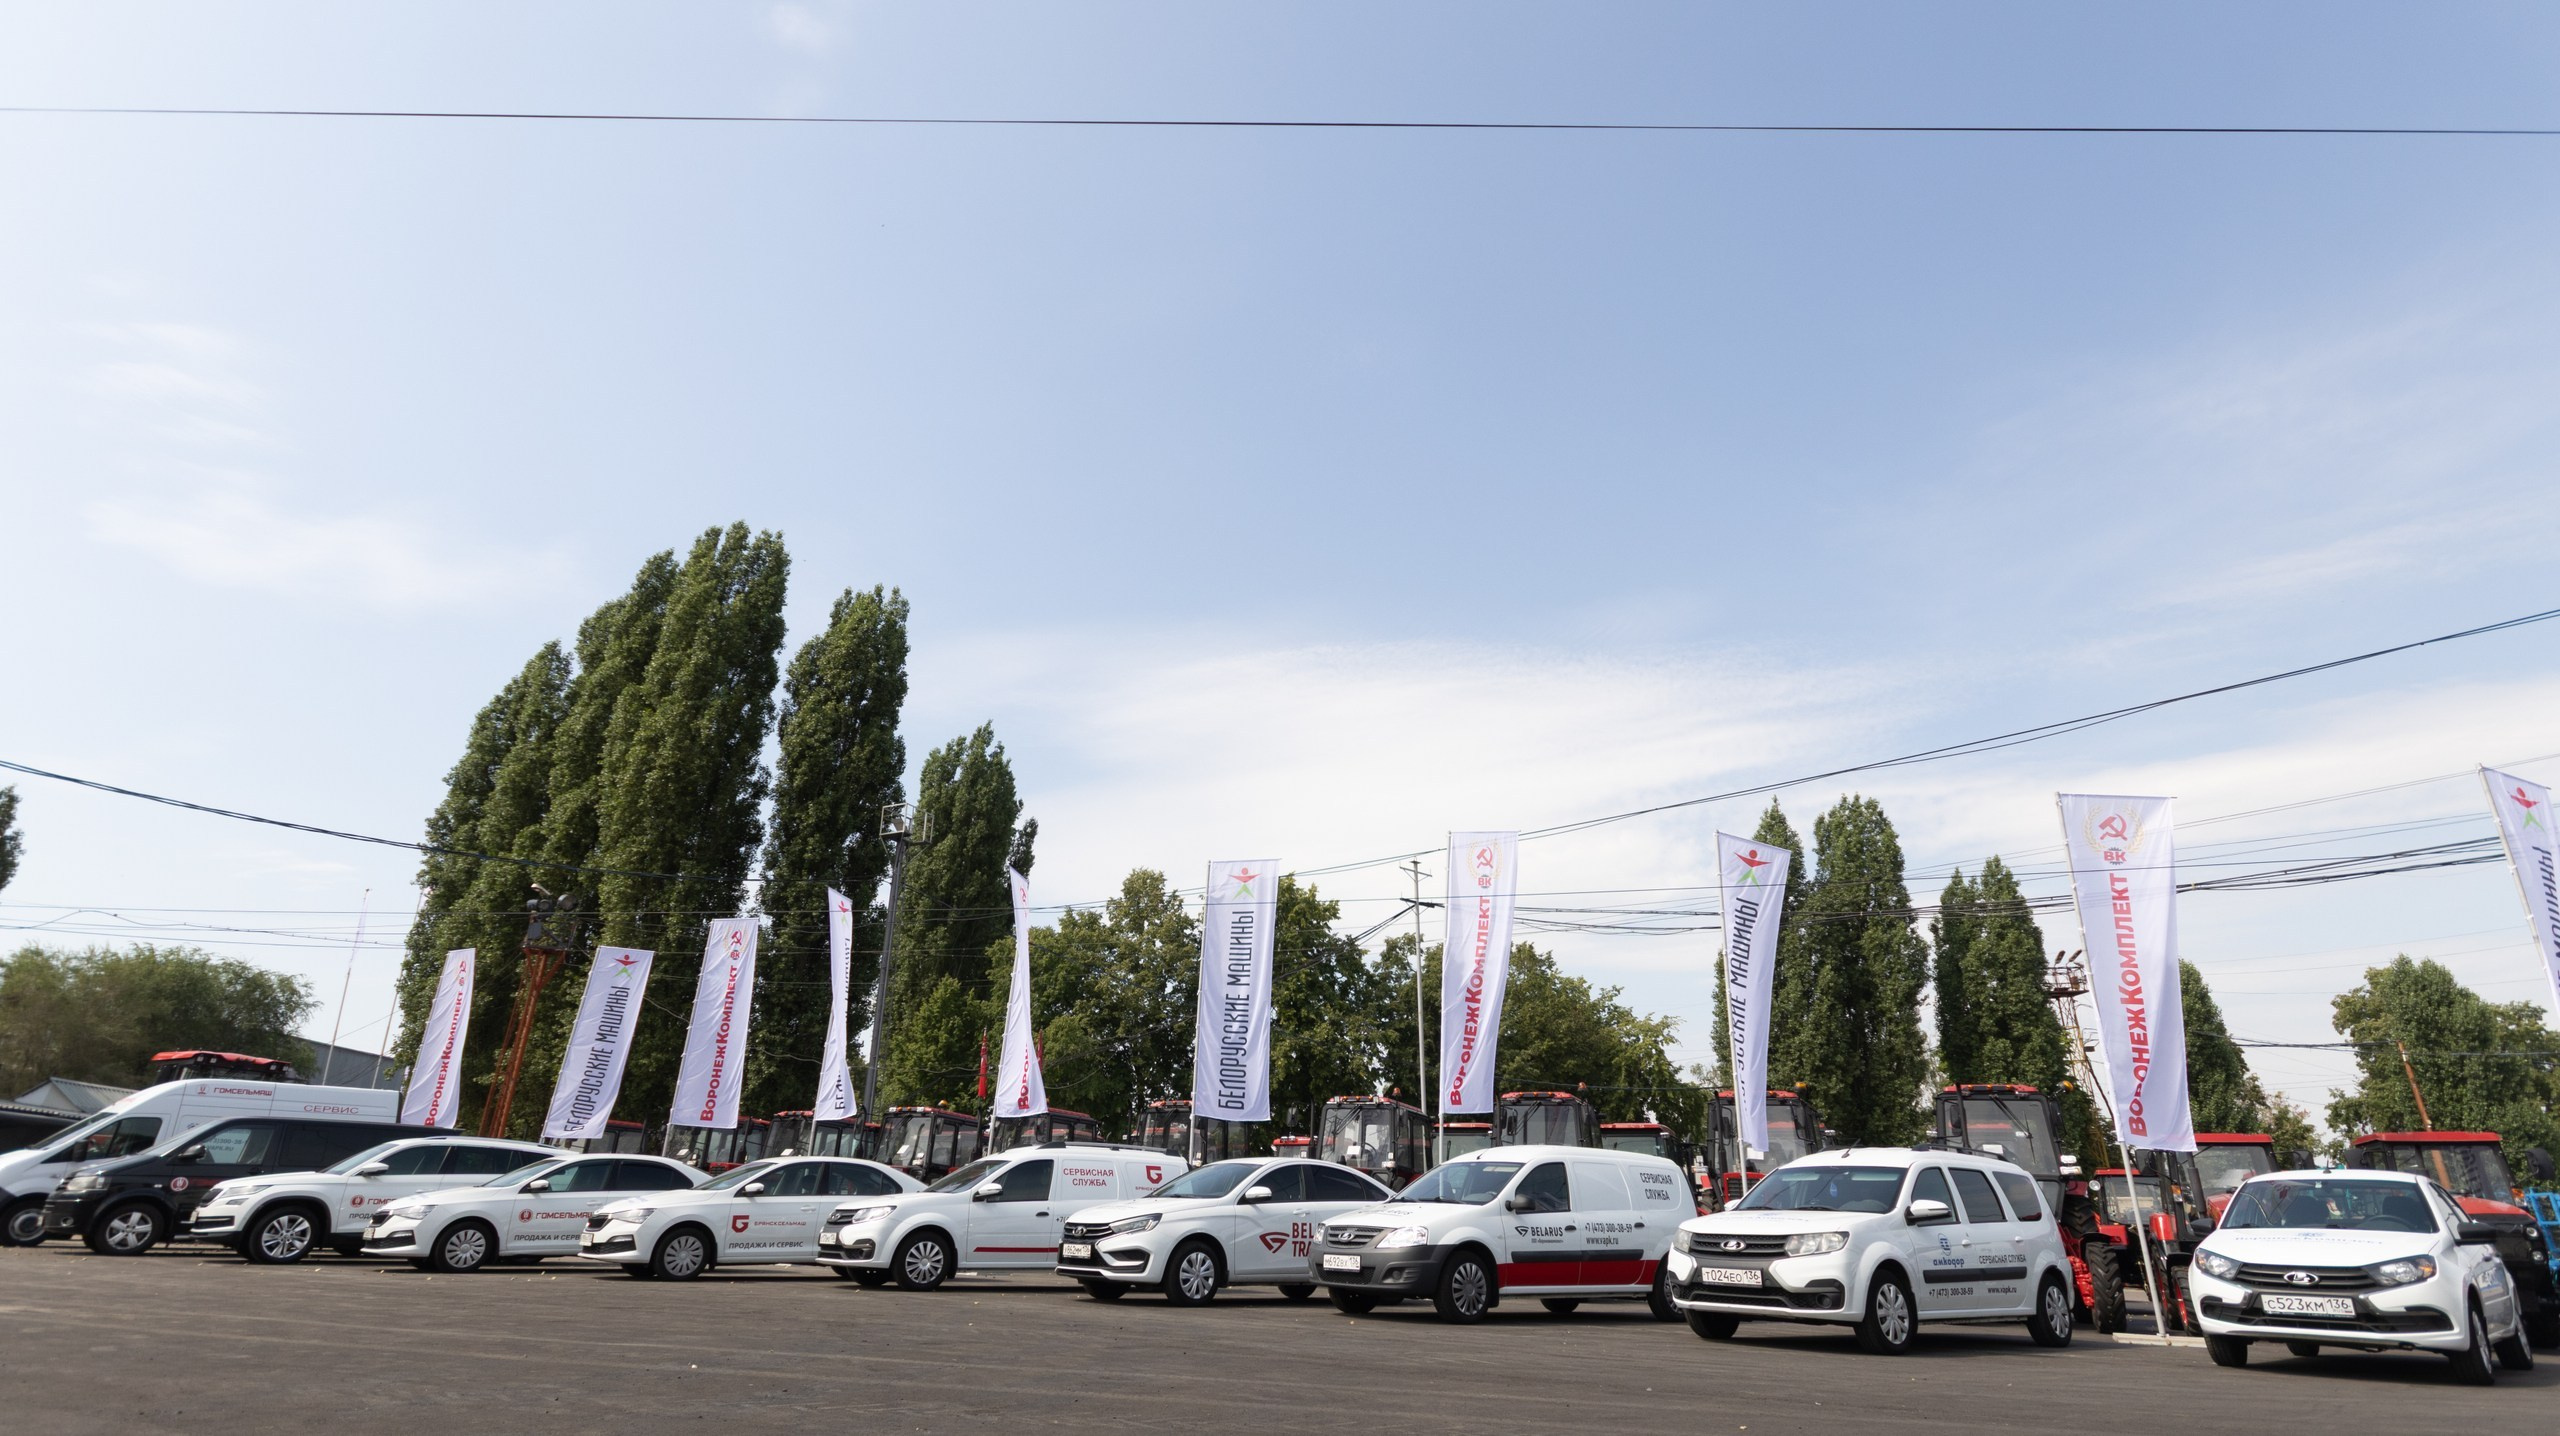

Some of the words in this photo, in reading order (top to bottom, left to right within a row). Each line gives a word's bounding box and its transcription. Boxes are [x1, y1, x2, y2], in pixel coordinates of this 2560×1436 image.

[2104, 850, 2127, 862] ВК
[1477, 876, 1492, 887] ВК
[1226, 910, 1254, 986] МАШИНЫ
[1731, 898, 1759, 988] МАШИНЫ
[595, 985, 630, 1044] МАШИНЫ
[1218, 994, 1249, 1110] БЕЛОРУССКИЕ
[213, 1087, 273, 1097] ГОМСЕЛЬМАШ
[303, 1105, 359, 1115] СЕРВИС
[1063, 1168, 1114, 1177] СЕРВИСНАЯ
[1640, 1172, 1673, 1185] СЕРВИСНАЯ
[1072, 1178, 1107, 1187] СЛУЖБА
[1644, 1188, 1671, 1201] СЛУЖБА
[1530, 1226, 1563, 1237] BELARUS
[514, 1234, 552, 1242] ПРОДАЖА
[1979, 1255, 2007, 1265] СЕРВИСНАЯ
[2008, 1254, 2027, 1263] СЛУЖБА
[1705, 1269, 1742, 1282] Т024ЕО
[1743, 1270, 1759, 1280] 136
[2267, 1298, 2325, 1312] С523КМ
[2326, 1298, 2349, 1309] 136
